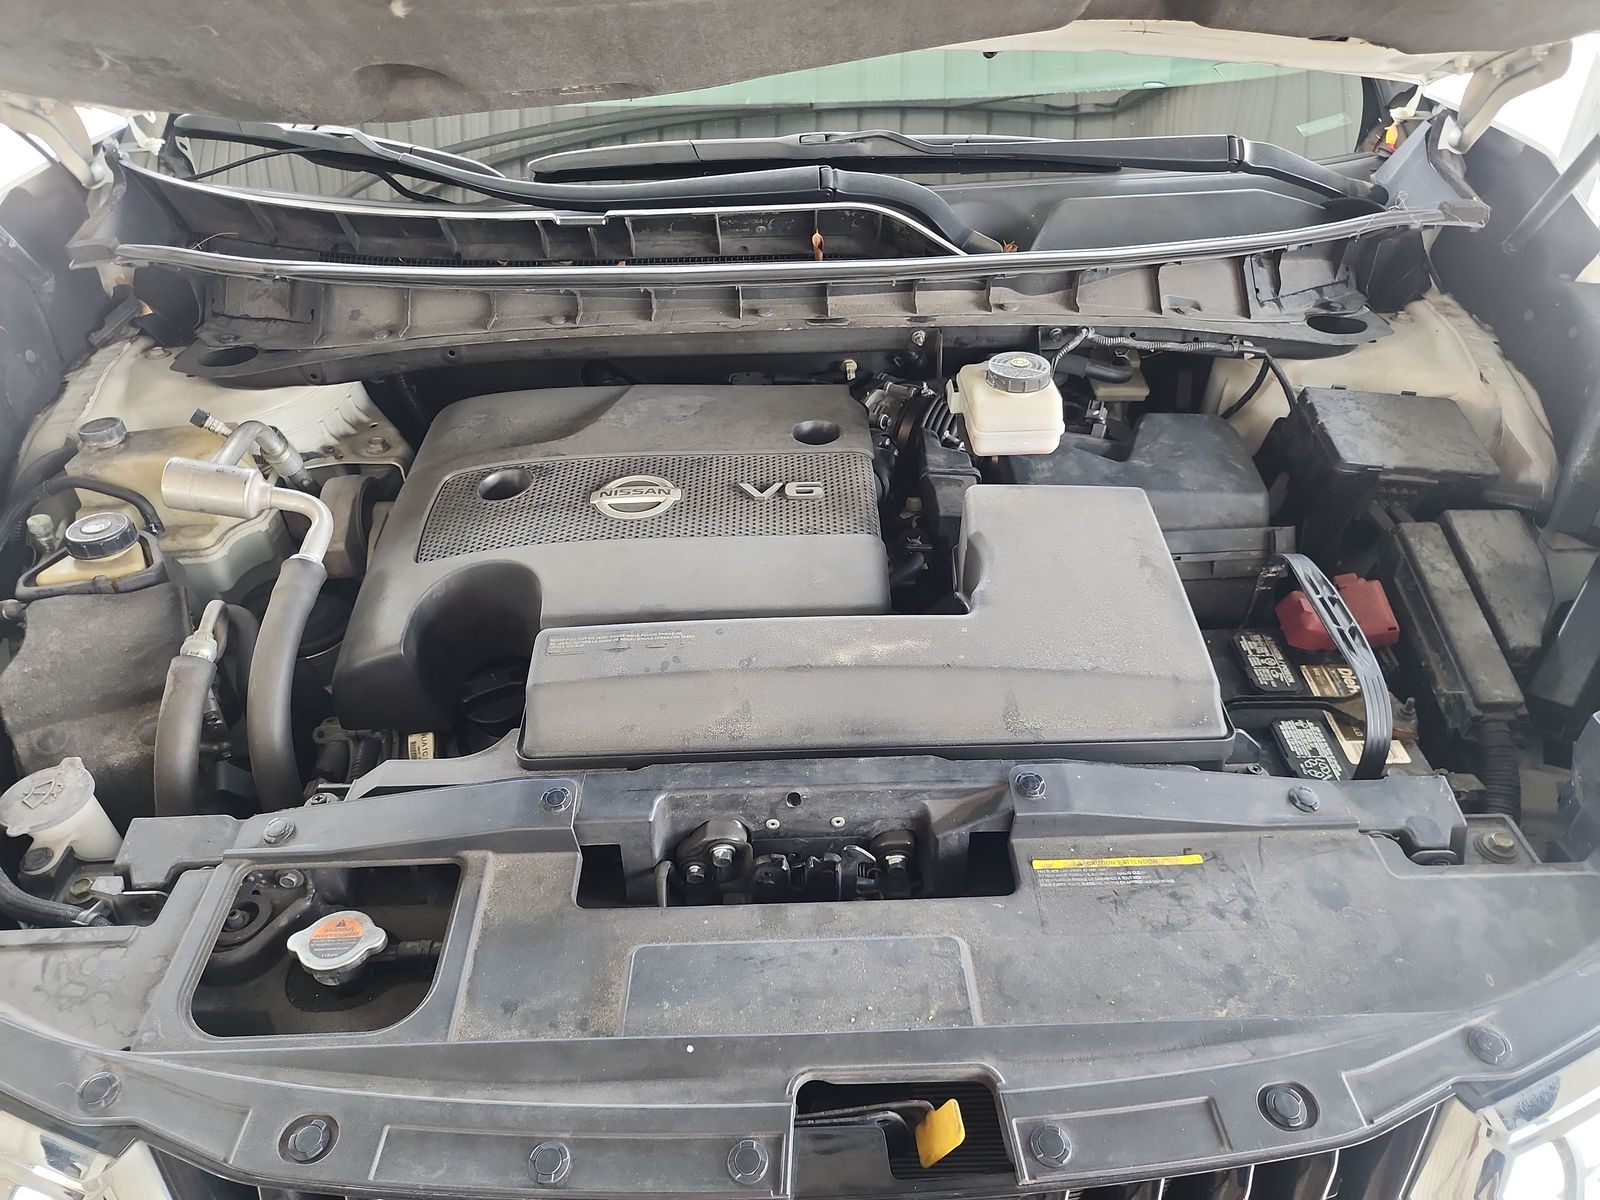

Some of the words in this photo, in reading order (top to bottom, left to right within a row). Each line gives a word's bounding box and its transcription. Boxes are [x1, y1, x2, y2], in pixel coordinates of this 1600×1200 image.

[599, 486, 672, 498] NISSAN
[737, 481, 825, 502] V6
[1337, 667, 1361, 694] DieH
